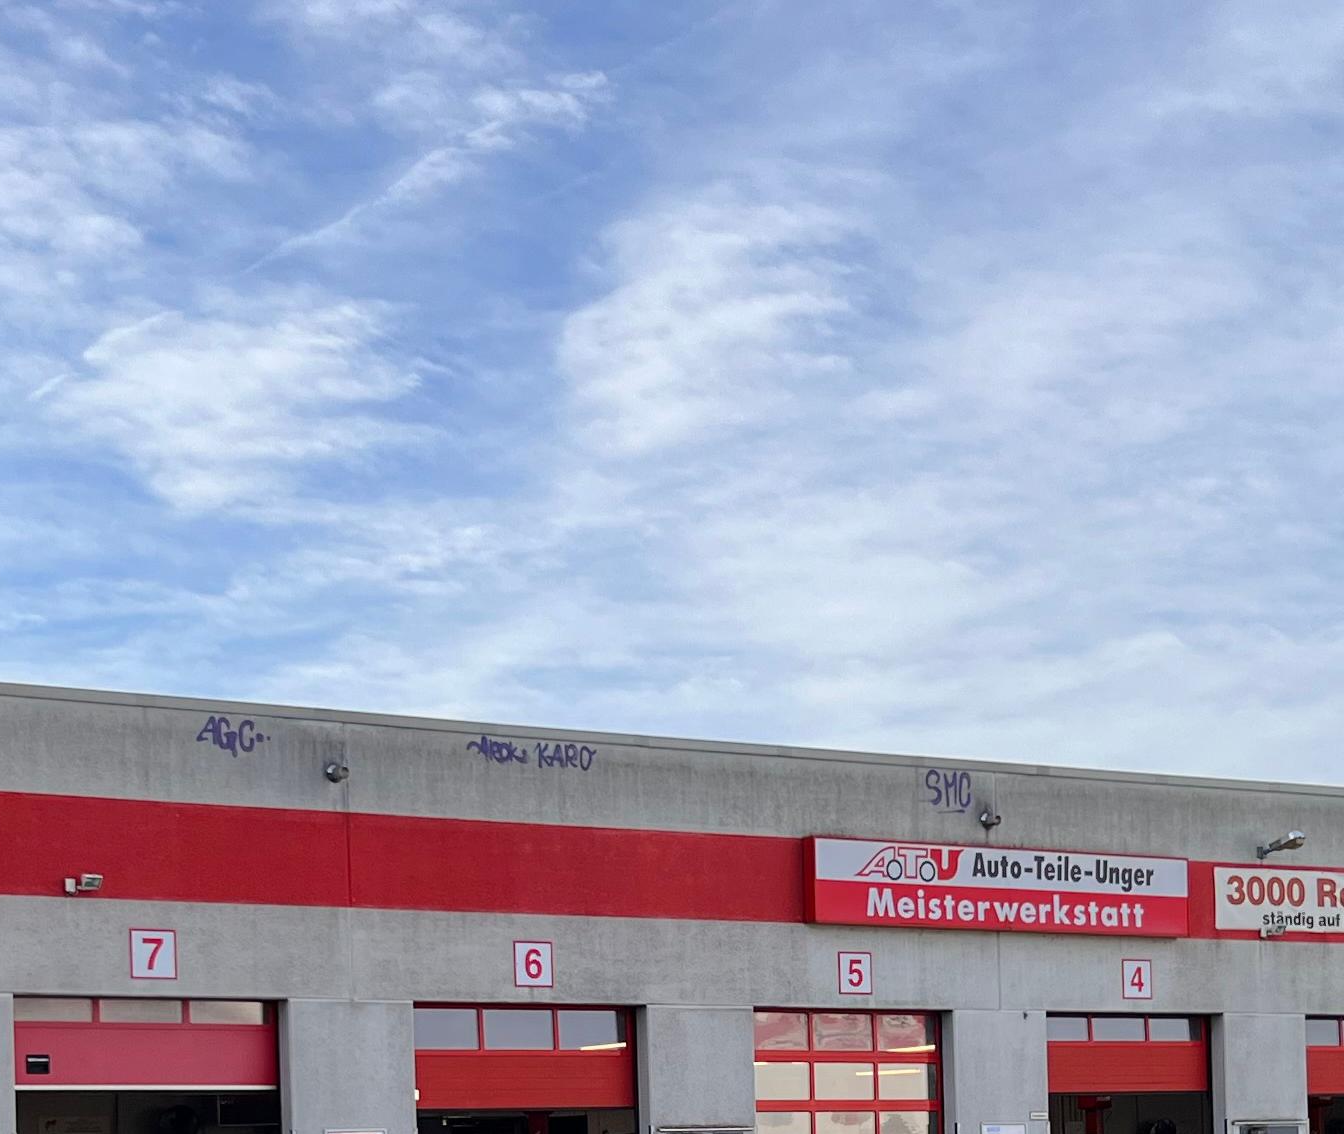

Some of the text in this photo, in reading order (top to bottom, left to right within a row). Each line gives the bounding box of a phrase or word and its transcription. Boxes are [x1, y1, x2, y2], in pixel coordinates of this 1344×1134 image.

[972, 852, 1155, 893] Auto-Teile-Unger
[1226, 875, 1305, 907] 3000
[866, 887, 1144, 928] Meisterwerkstatt
[1262, 912, 1314, 929] ständig
[1318, 914, 1341, 928] auf
[141, 937, 164, 971] 7
[524, 948, 542, 979] 6
[848, 959, 863, 987] 5
[1130, 967, 1144, 993] 4
